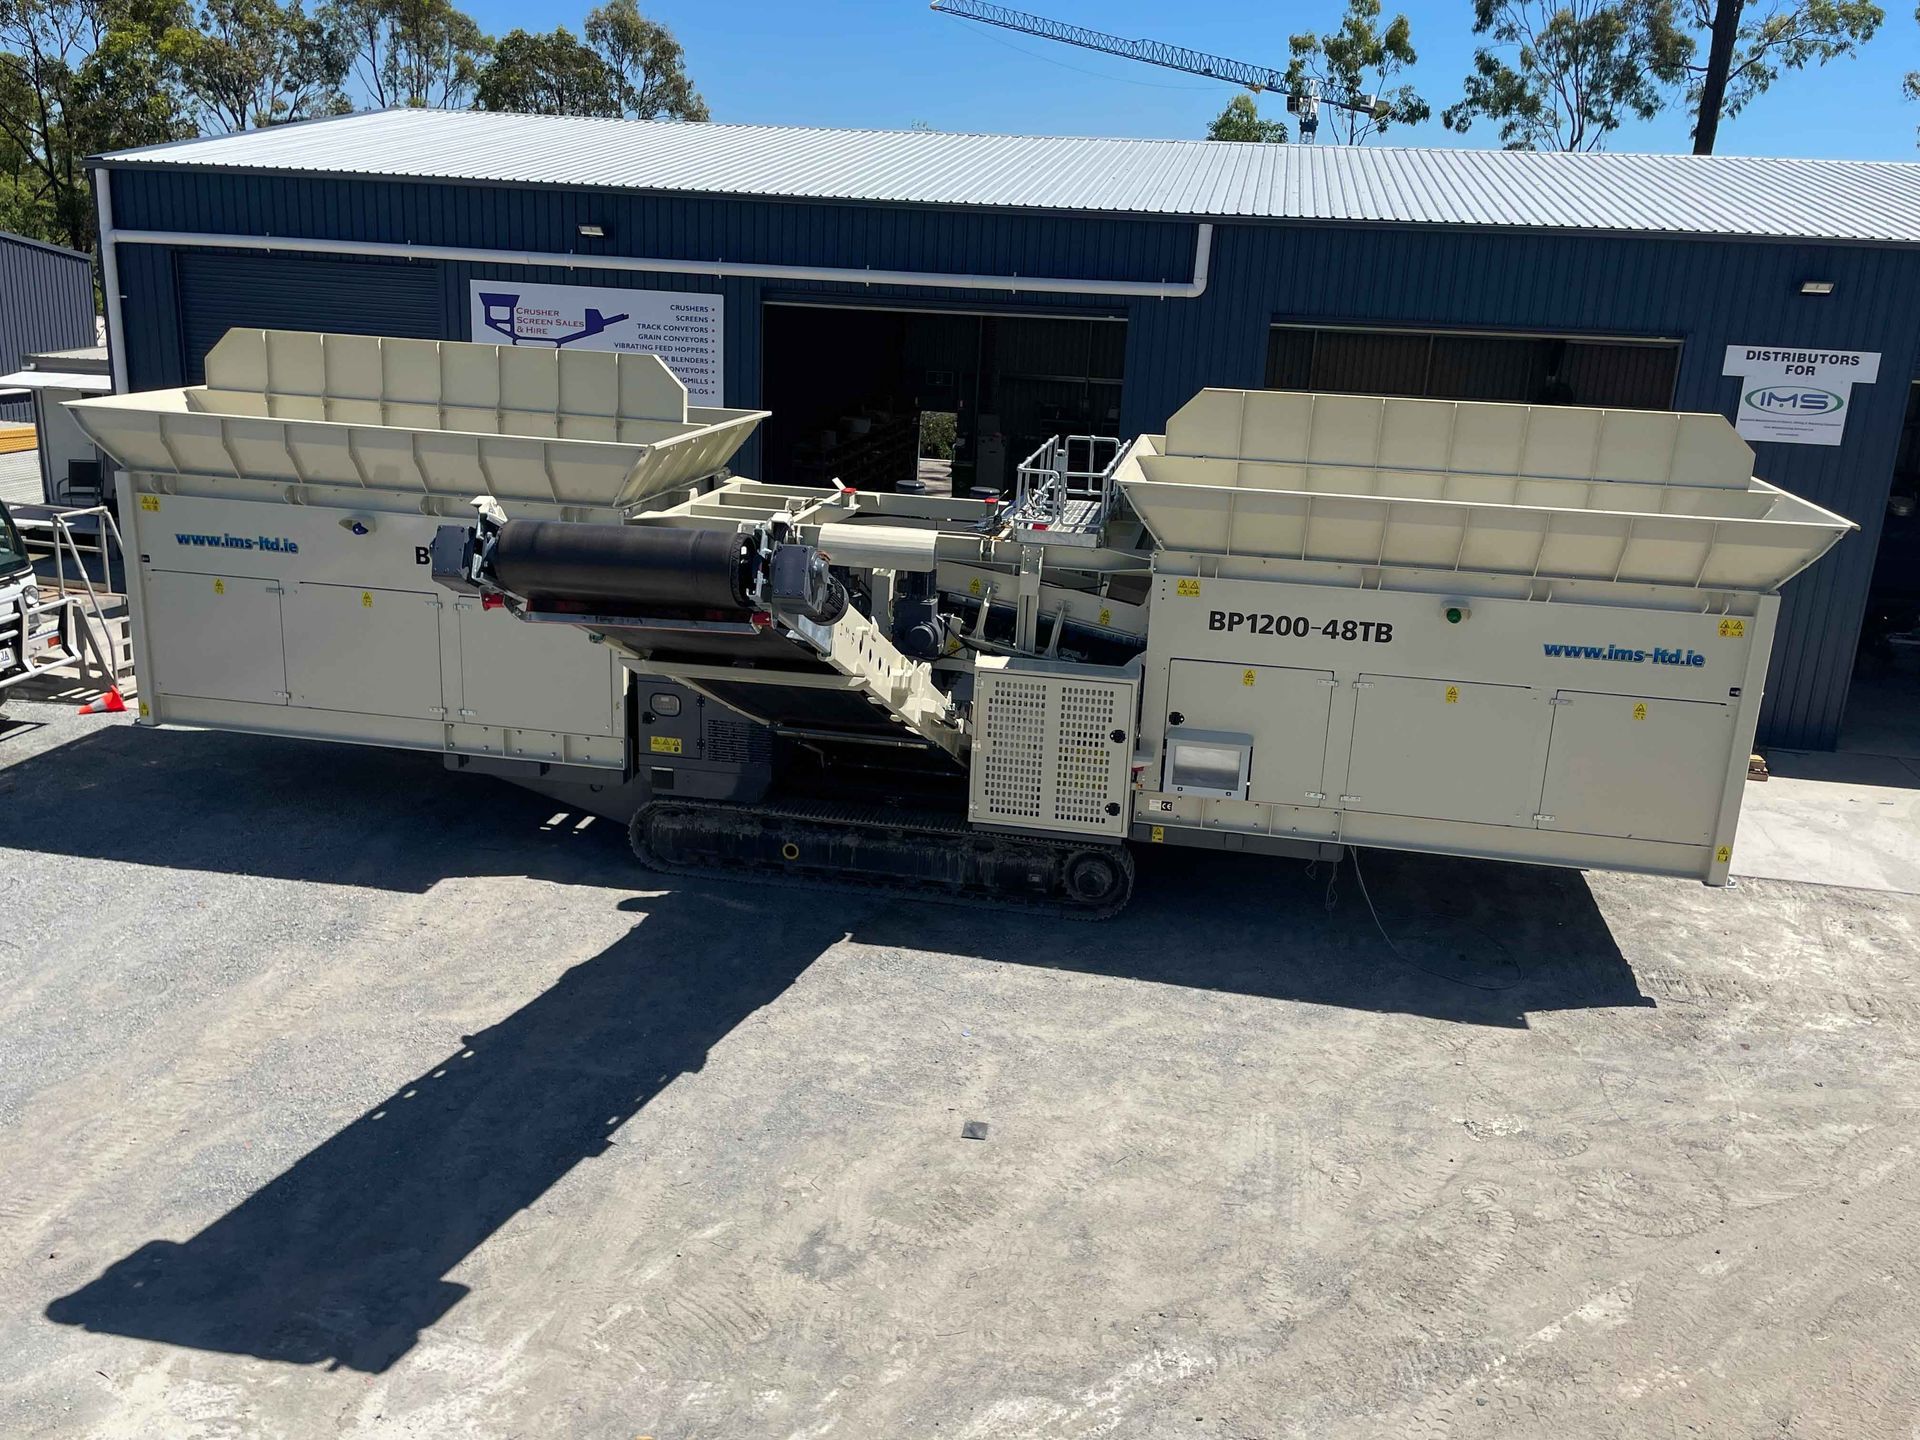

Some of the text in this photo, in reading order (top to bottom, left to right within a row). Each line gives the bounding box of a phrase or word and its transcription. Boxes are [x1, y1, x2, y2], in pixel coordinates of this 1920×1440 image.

[669, 304, 709, 313] CRUSHERS
[555, 318, 585, 328] SALES
[675, 315, 709, 323] SCREENS
[526, 326, 548, 335] HIRE
[636, 323, 709, 334] TRACK CONVEYORS
[638, 333, 709, 344] GRAIN CONVEYORS
[613, 342, 709, 354] VIBRATING FEED HOPPERS
[671, 356, 709, 364] BLENDERS
[1745, 350, 1860, 366] DISTRIBUTORS
[669, 366, 709, 375] ONVEYORS
[1785, 364, 1816, 376] FOR
[680, 377, 709, 385] GMILLS
[1760, 391, 1829, 410] IMS
[175, 532, 299, 554] www.ims-ltd.ie
[1208, 610, 1394, 644] BP1200-48TB
[1543, 643, 1706, 668] www.ims-ltd.ie
